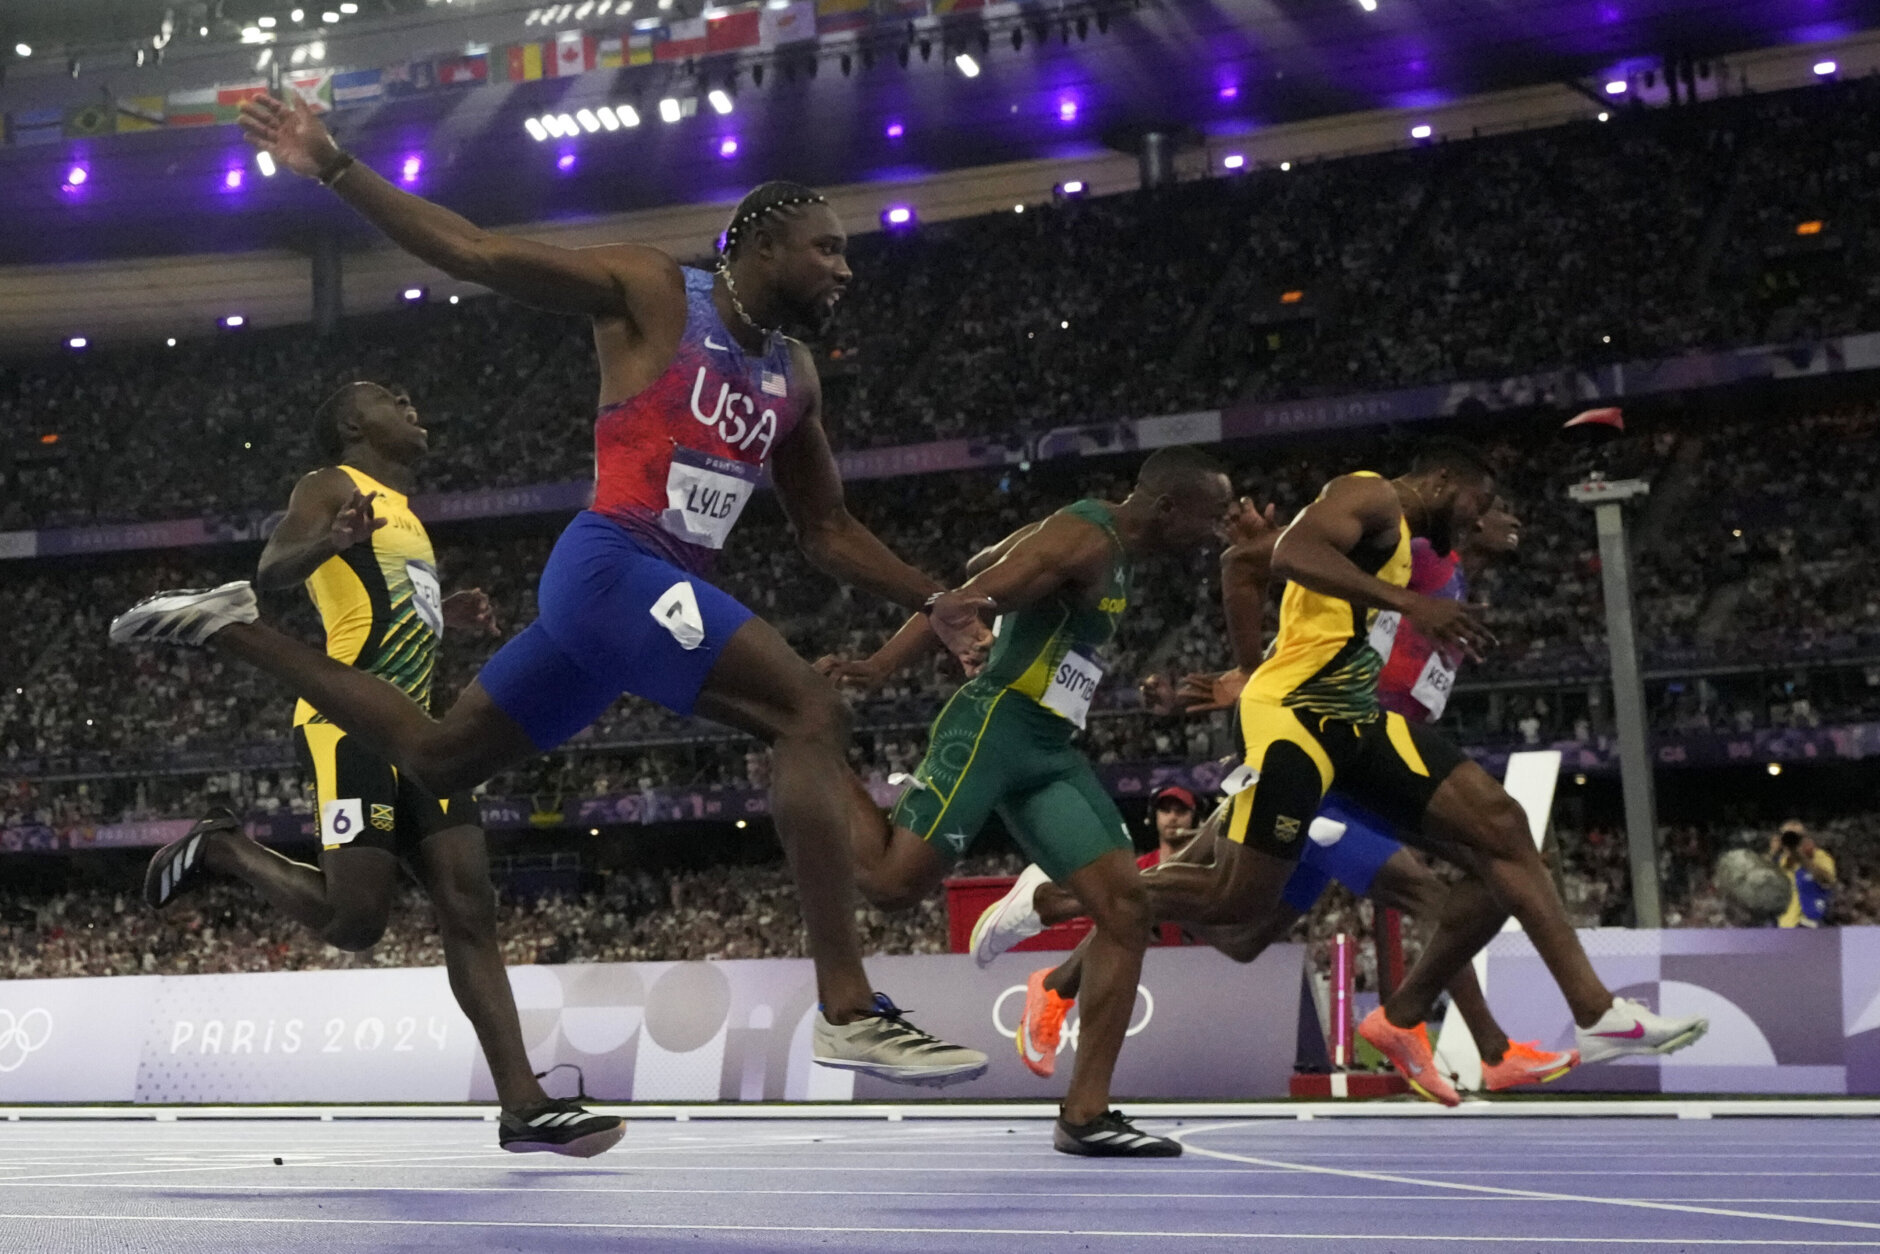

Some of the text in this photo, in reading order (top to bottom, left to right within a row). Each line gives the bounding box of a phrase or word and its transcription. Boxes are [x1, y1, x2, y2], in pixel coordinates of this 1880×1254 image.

[690, 366, 775, 460] USA
[333, 808, 351, 835] 6
[322, 1016, 449, 1052] 2024
